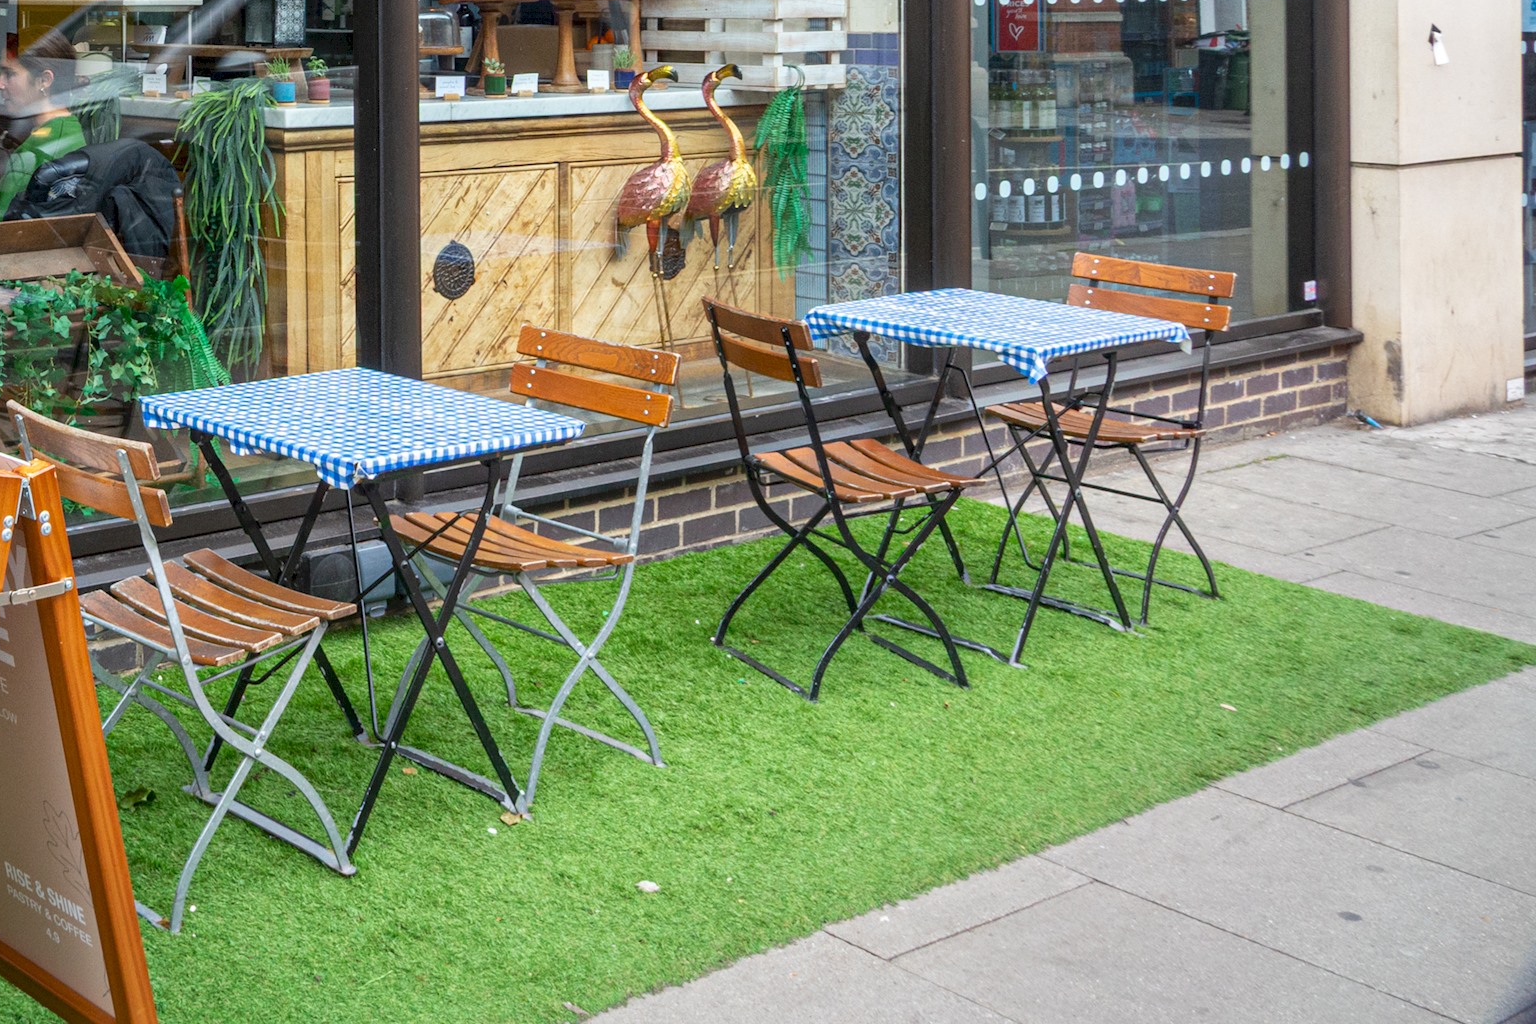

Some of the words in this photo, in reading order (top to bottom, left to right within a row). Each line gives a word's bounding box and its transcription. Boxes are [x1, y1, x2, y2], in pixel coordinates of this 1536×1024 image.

[4, 861, 33, 893] RISE
[35, 880, 45, 899] &
[47, 887, 87, 926] SHINE
[6, 884, 43, 915] PASTRY
[45, 907, 52, 921] &
[53, 913, 94, 947] COFFEE
